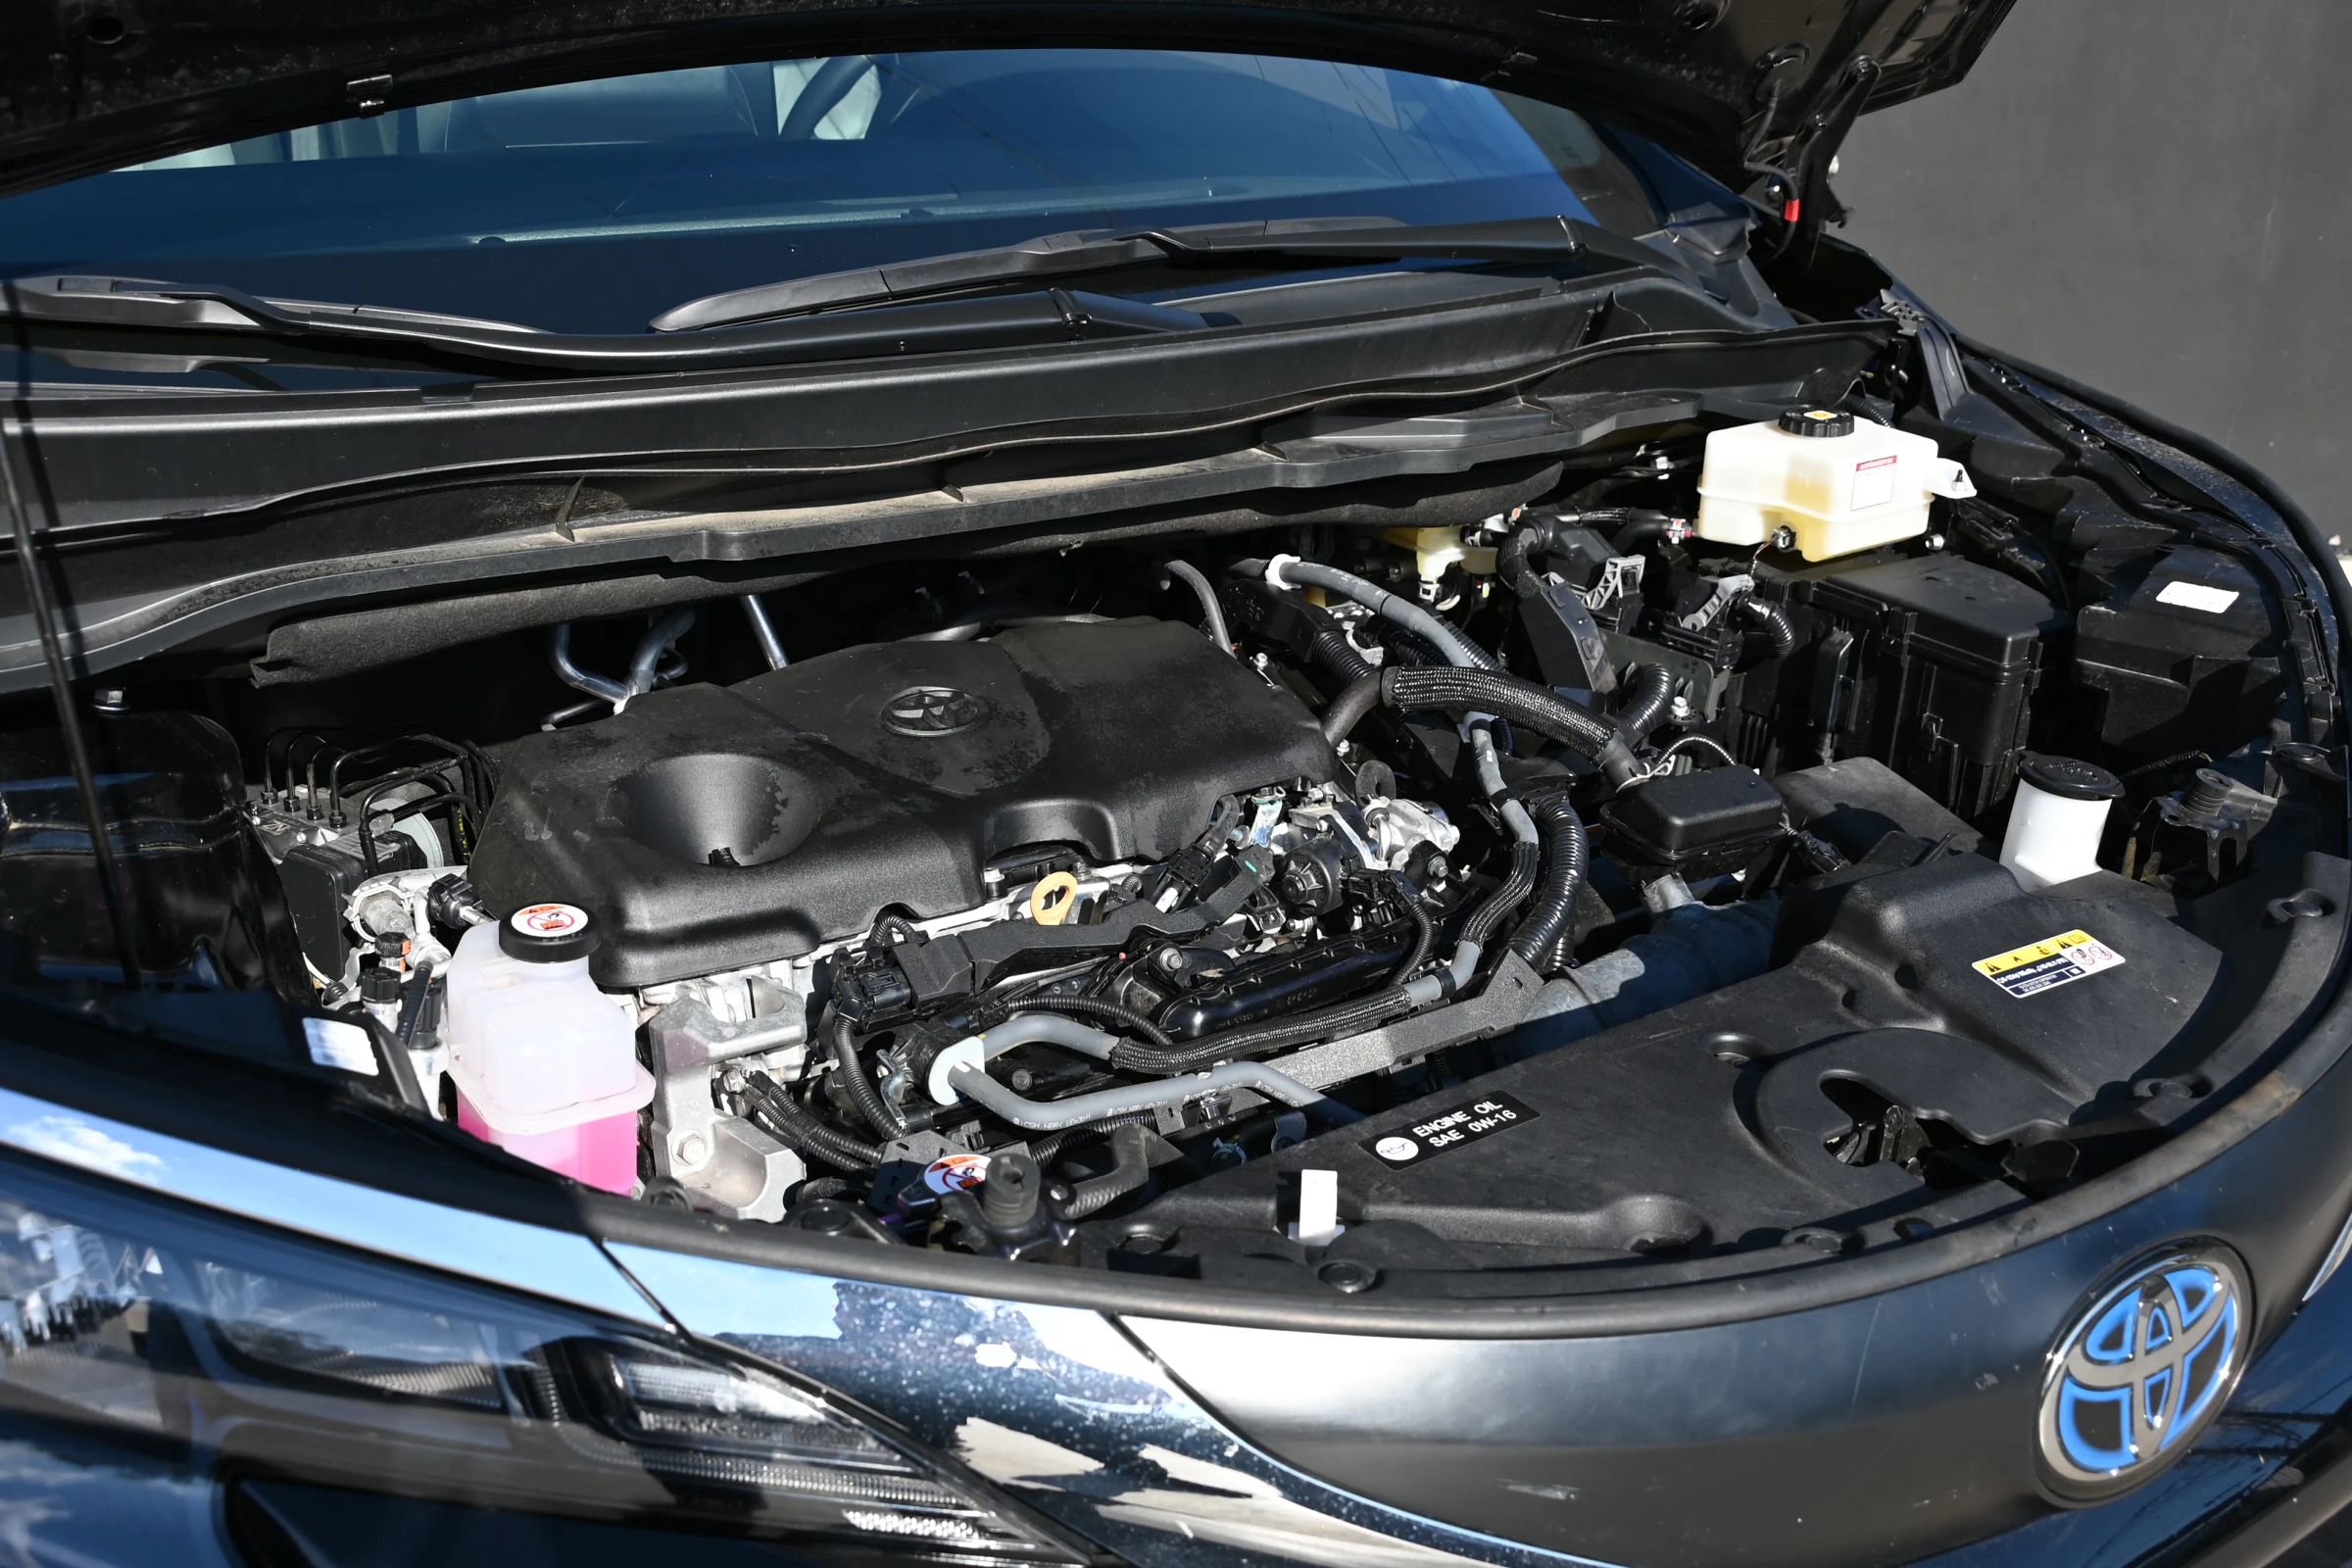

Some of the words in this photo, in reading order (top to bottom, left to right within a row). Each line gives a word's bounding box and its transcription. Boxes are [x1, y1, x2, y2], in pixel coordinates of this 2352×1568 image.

[1412, 1110, 1471, 1137] ENGINE
[1474, 1101, 1503, 1114] OIL
[1429, 1129, 1465, 1147] SAE
[1468, 1109, 1517, 1132] 0W-16
